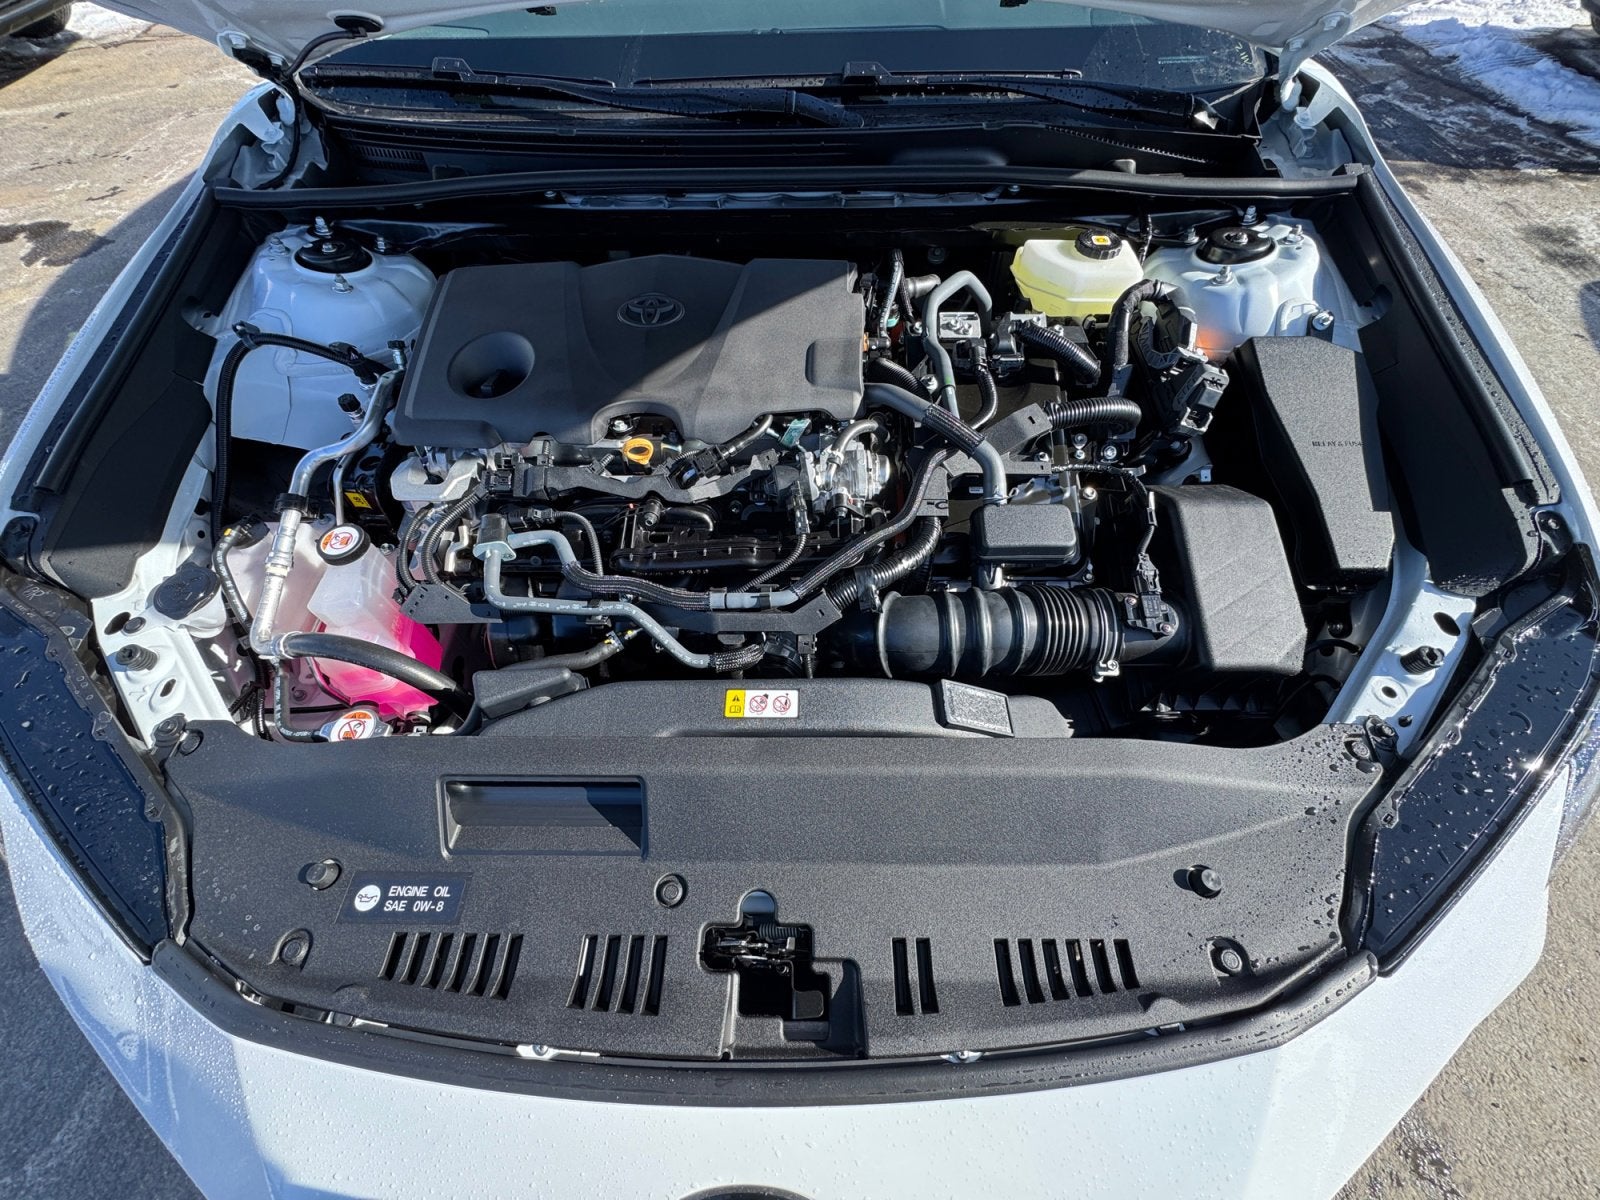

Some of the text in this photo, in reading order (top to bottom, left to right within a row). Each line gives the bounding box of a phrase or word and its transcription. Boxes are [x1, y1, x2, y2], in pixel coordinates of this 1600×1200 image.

[388, 885, 451, 898] ENGINE OIL
[383, 900, 445, 912] SAE 0W-8
